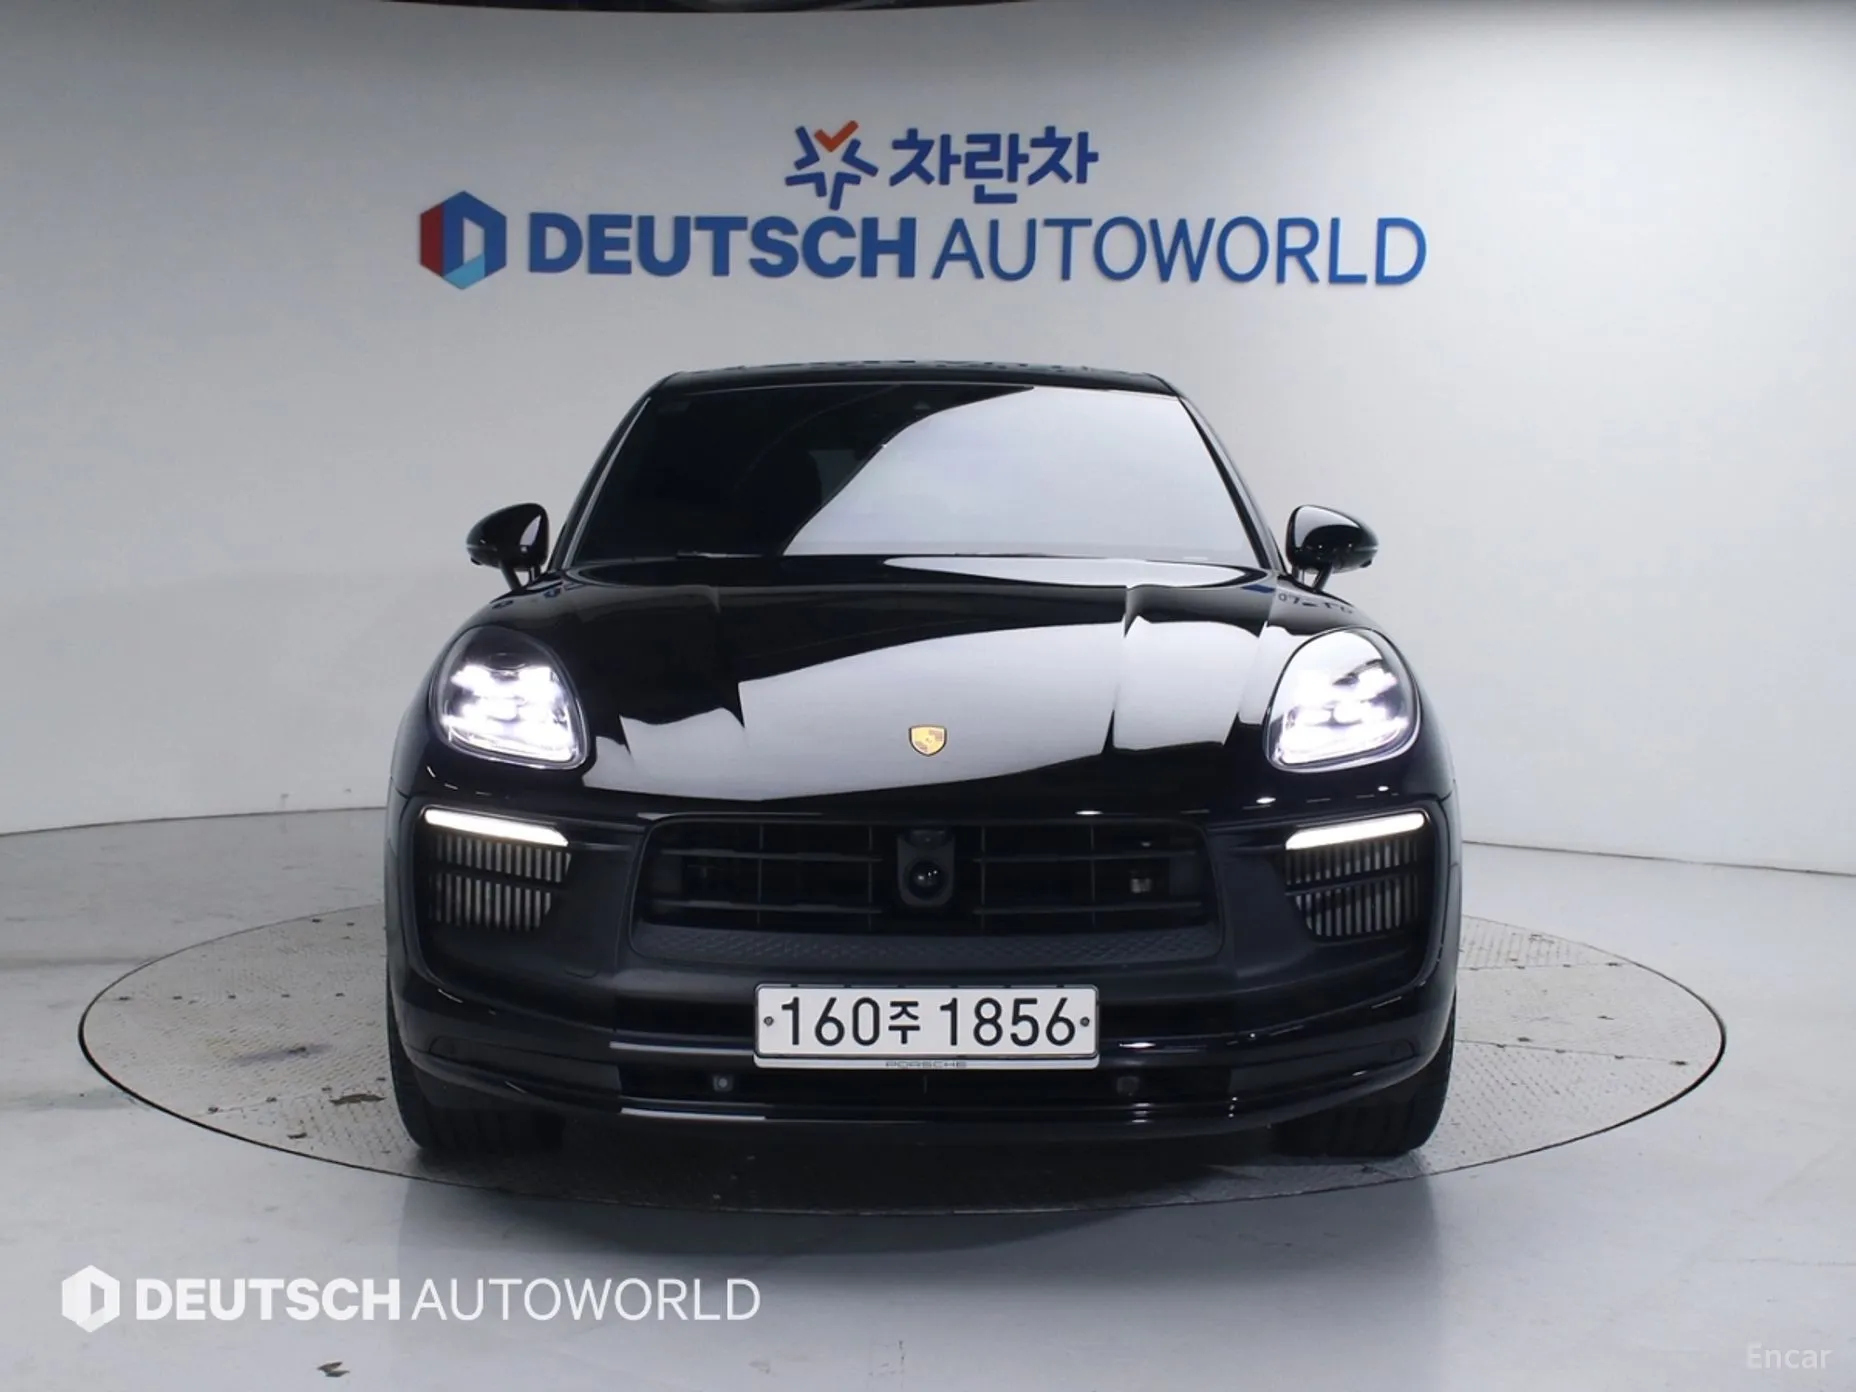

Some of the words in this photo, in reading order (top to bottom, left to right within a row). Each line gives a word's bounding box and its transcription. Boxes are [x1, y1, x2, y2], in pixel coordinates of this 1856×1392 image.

[889, 125, 1099, 204] 차란차
[528, 211, 917, 280] DEUTSCH
[931, 215, 1427, 286] AUTOWORLD
[781, 996, 921, 1046] 160주
[939, 997, 1076, 1047] 1856
